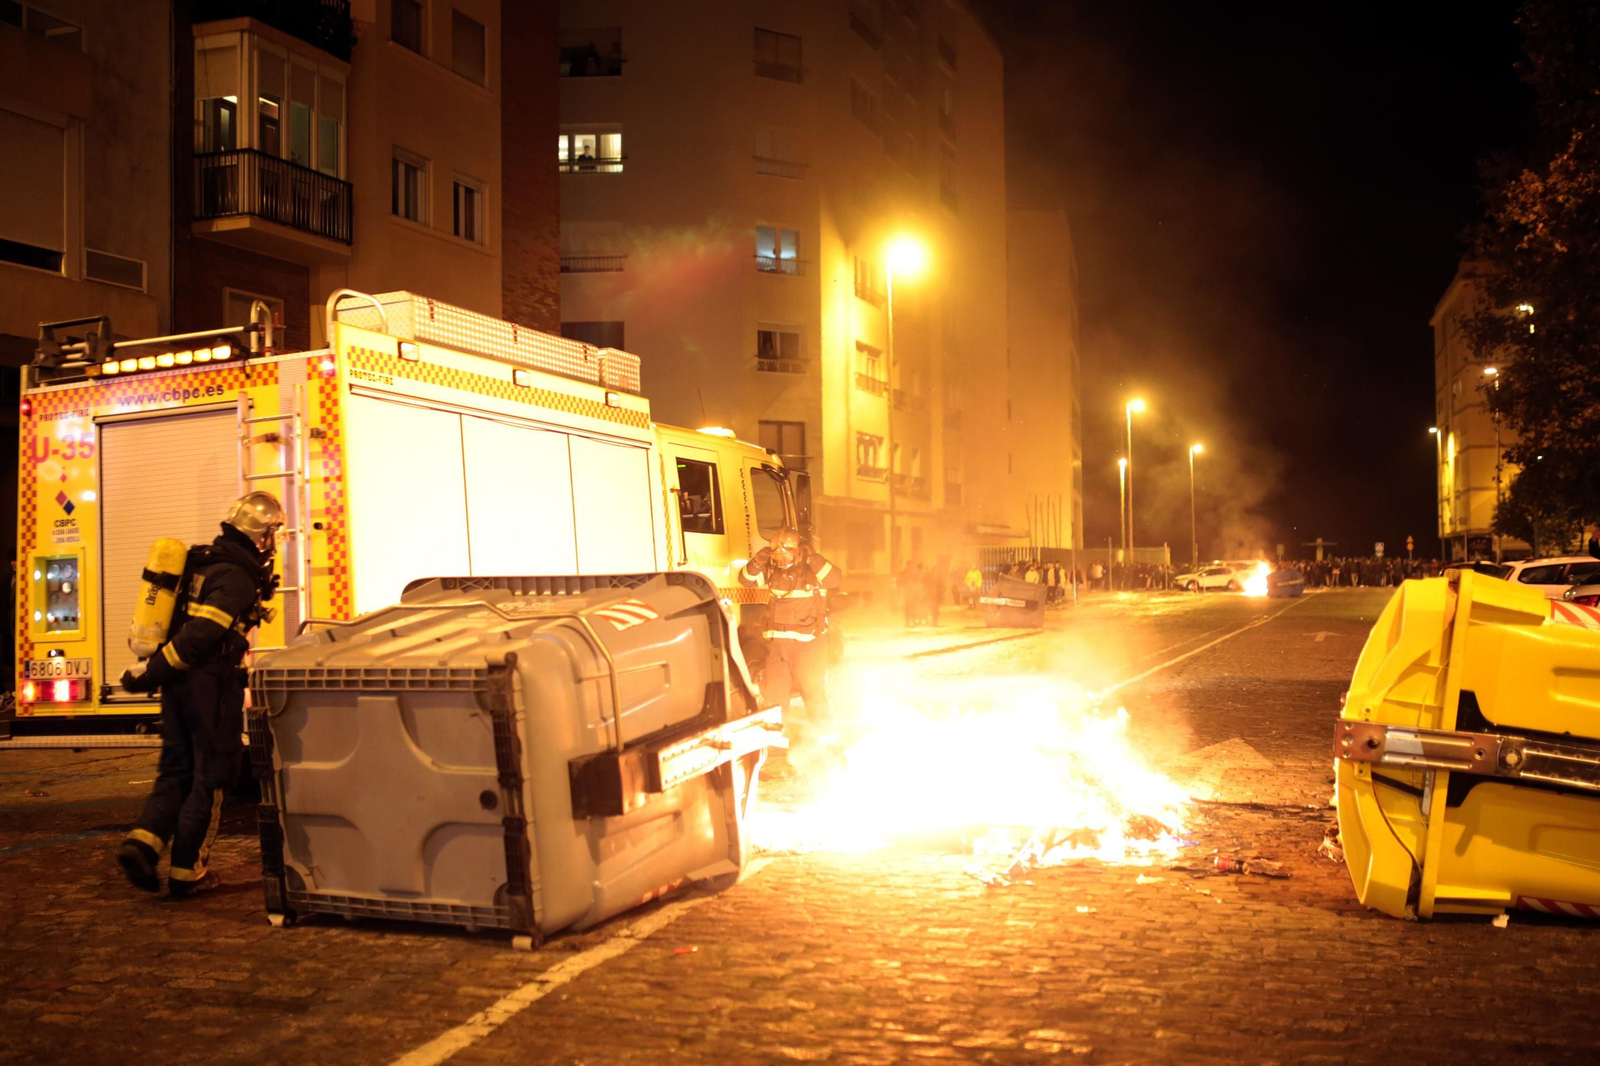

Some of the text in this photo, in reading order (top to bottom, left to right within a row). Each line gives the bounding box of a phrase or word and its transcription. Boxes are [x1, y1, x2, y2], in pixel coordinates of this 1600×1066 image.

[119, 384, 224, 406] www.cbpc.es
[32, 432, 95, 463] U-35
[53, 518, 77, 528] CBPC
[66, 660, 90, 675] DVJ
